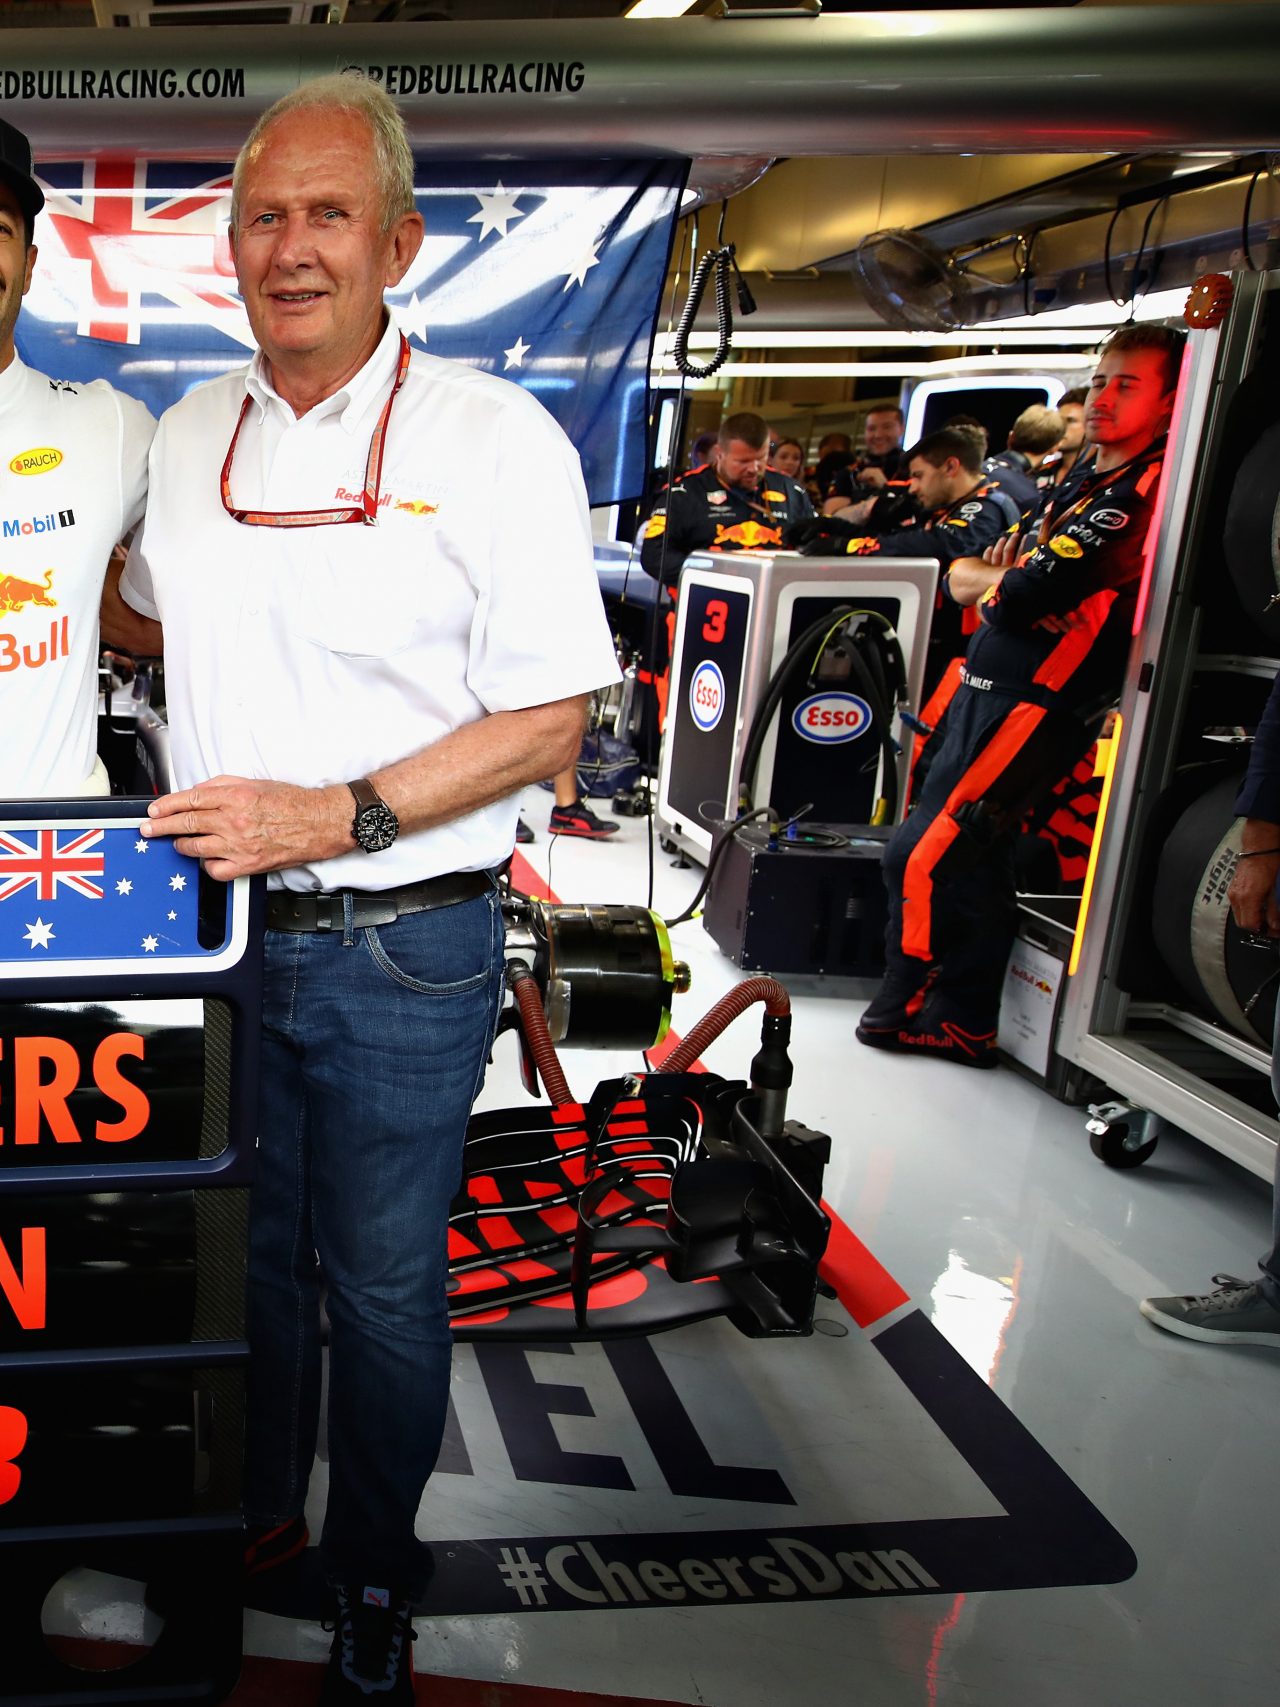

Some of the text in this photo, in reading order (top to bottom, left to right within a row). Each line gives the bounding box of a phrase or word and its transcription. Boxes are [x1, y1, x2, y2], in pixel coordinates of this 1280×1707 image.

[23, 453, 57, 470] RAUCH
[335, 488, 363, 503] Red
[2, 514, 55, 538] Mobil
[702, 600, 729, 643] 3
[697, 679, 718, 709] Esso
[970, 676, 993, 691] MILES
[807, 706, 859, 727] Esso
[1202, 848, 1234, 905] Right
[898, 1030, 953, 1048] Red Bull
[497, 1538, 939, 1605] #CheersDan
